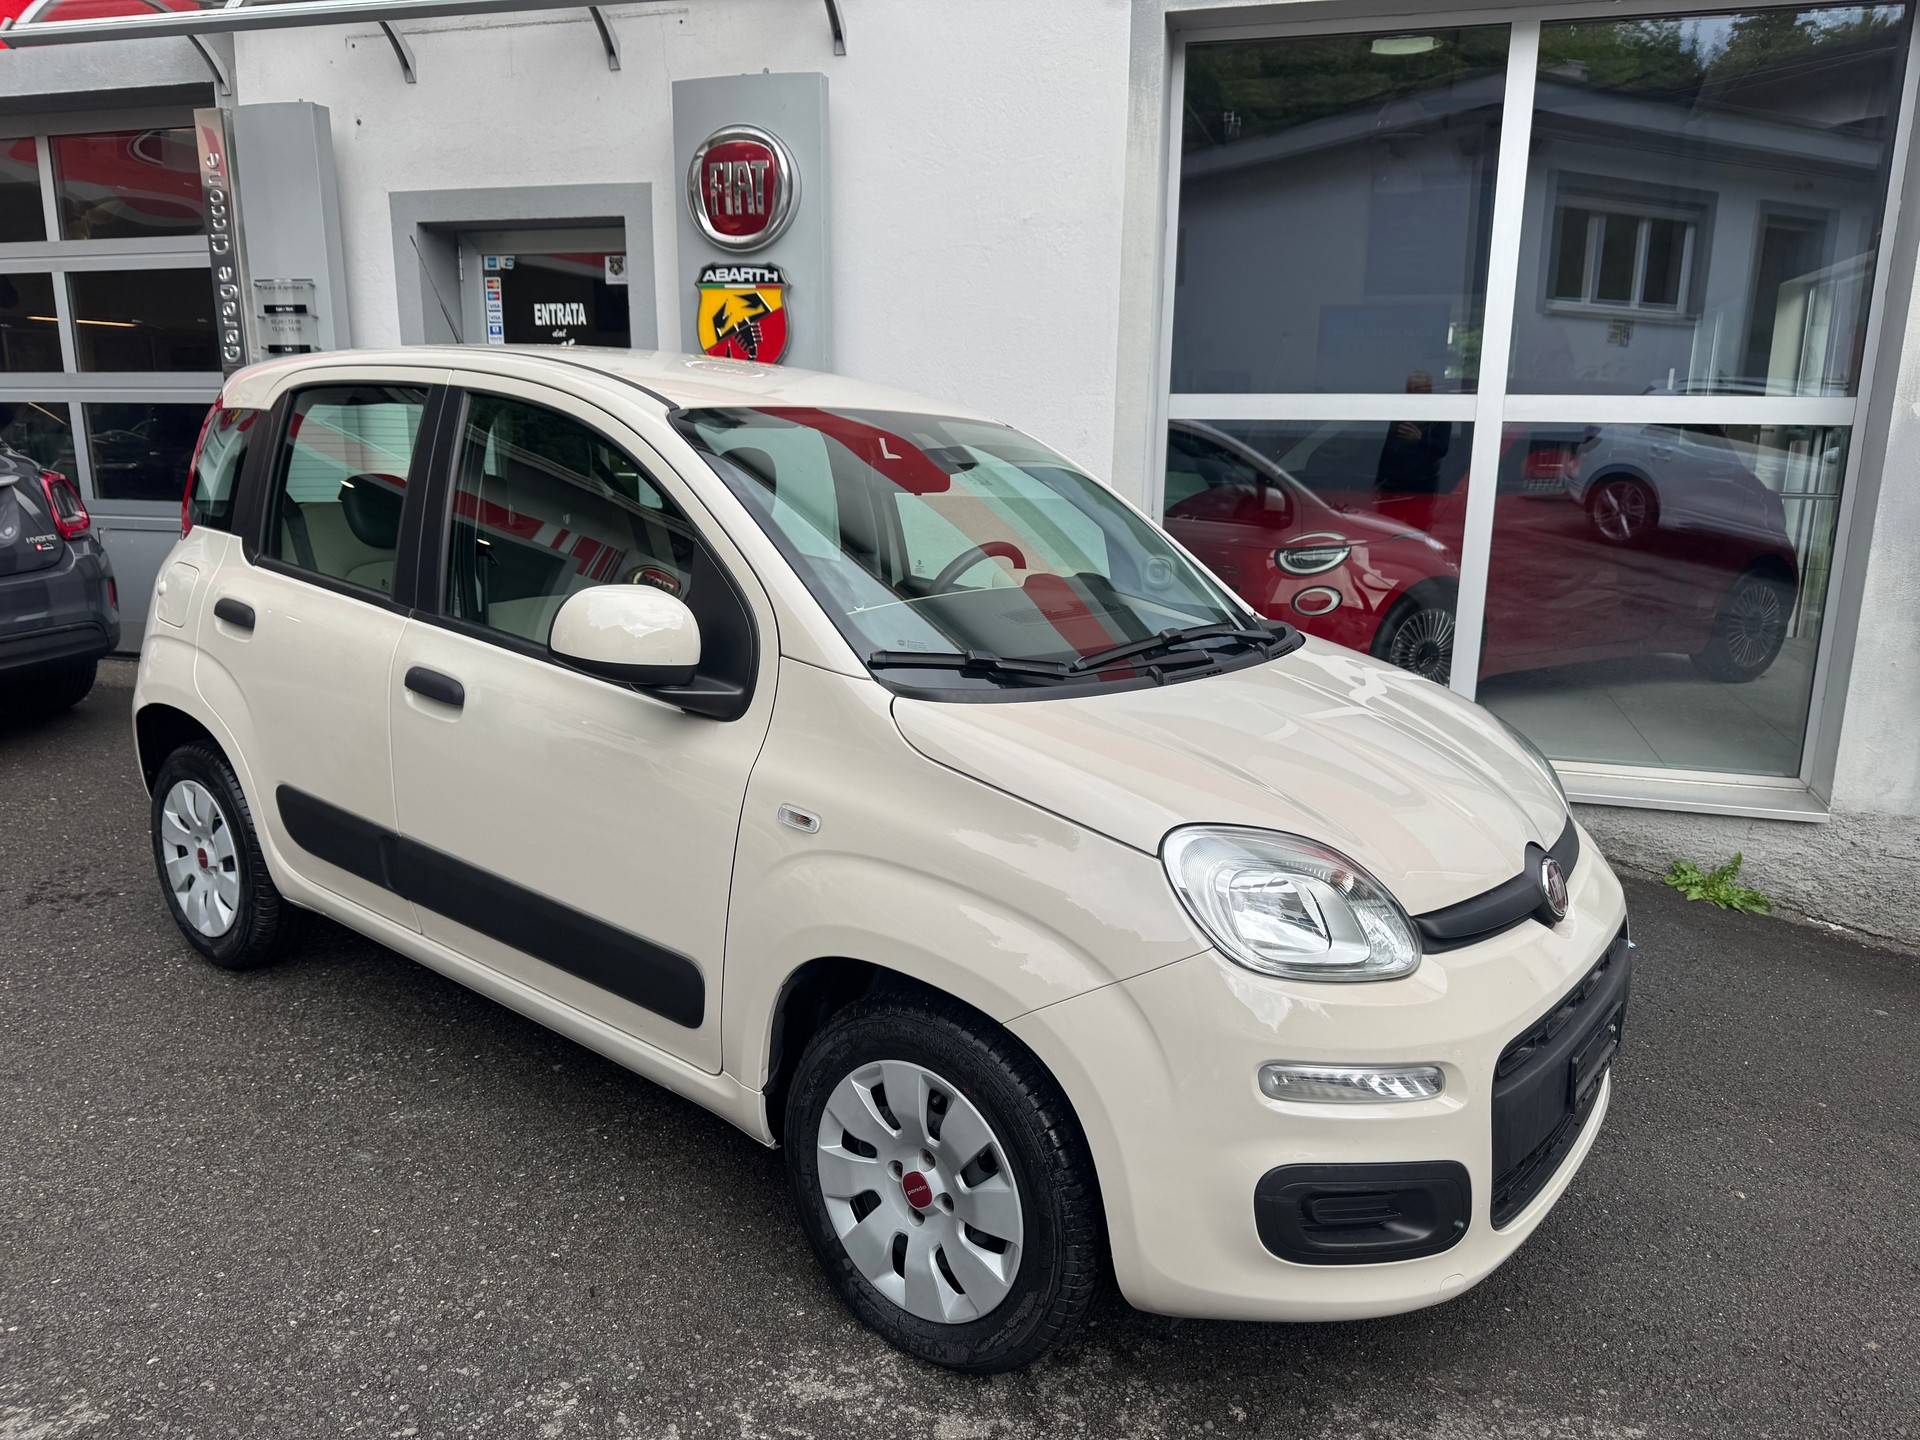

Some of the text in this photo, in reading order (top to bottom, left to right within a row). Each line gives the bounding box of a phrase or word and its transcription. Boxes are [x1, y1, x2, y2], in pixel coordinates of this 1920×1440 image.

[709, 160, 769, 216] FIAT
[702, 267, 779, 283] ABARTH
[534, 303, 587, 326] ENTRATA
